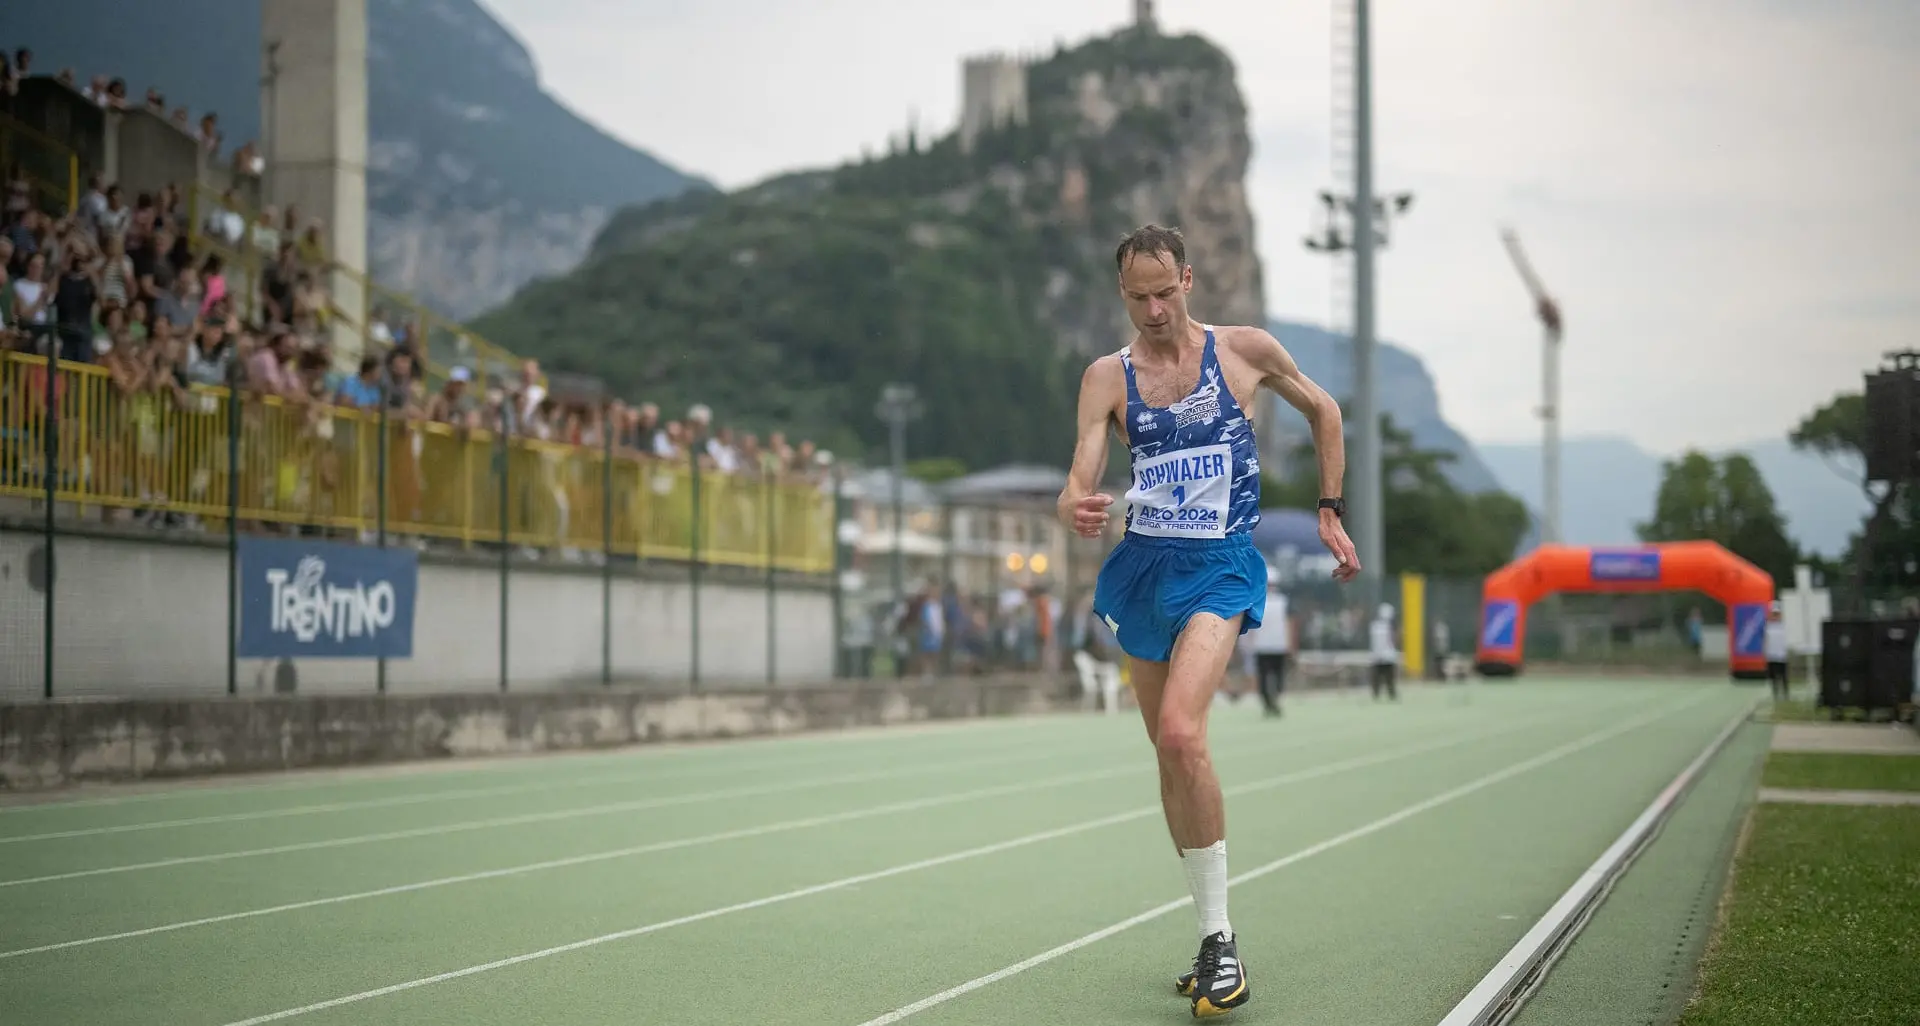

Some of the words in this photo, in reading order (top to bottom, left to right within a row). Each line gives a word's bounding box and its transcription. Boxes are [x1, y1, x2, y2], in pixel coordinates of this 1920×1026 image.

[1192, 402, 1218, 414] ATLETICA
[1140, 454, 1224, 491] SCHWAZER
[1172, 485, 1185, 507] 1
[1178, 509, 1218, 521] 2024
[266, 567, 396, 643] TRENTINO
